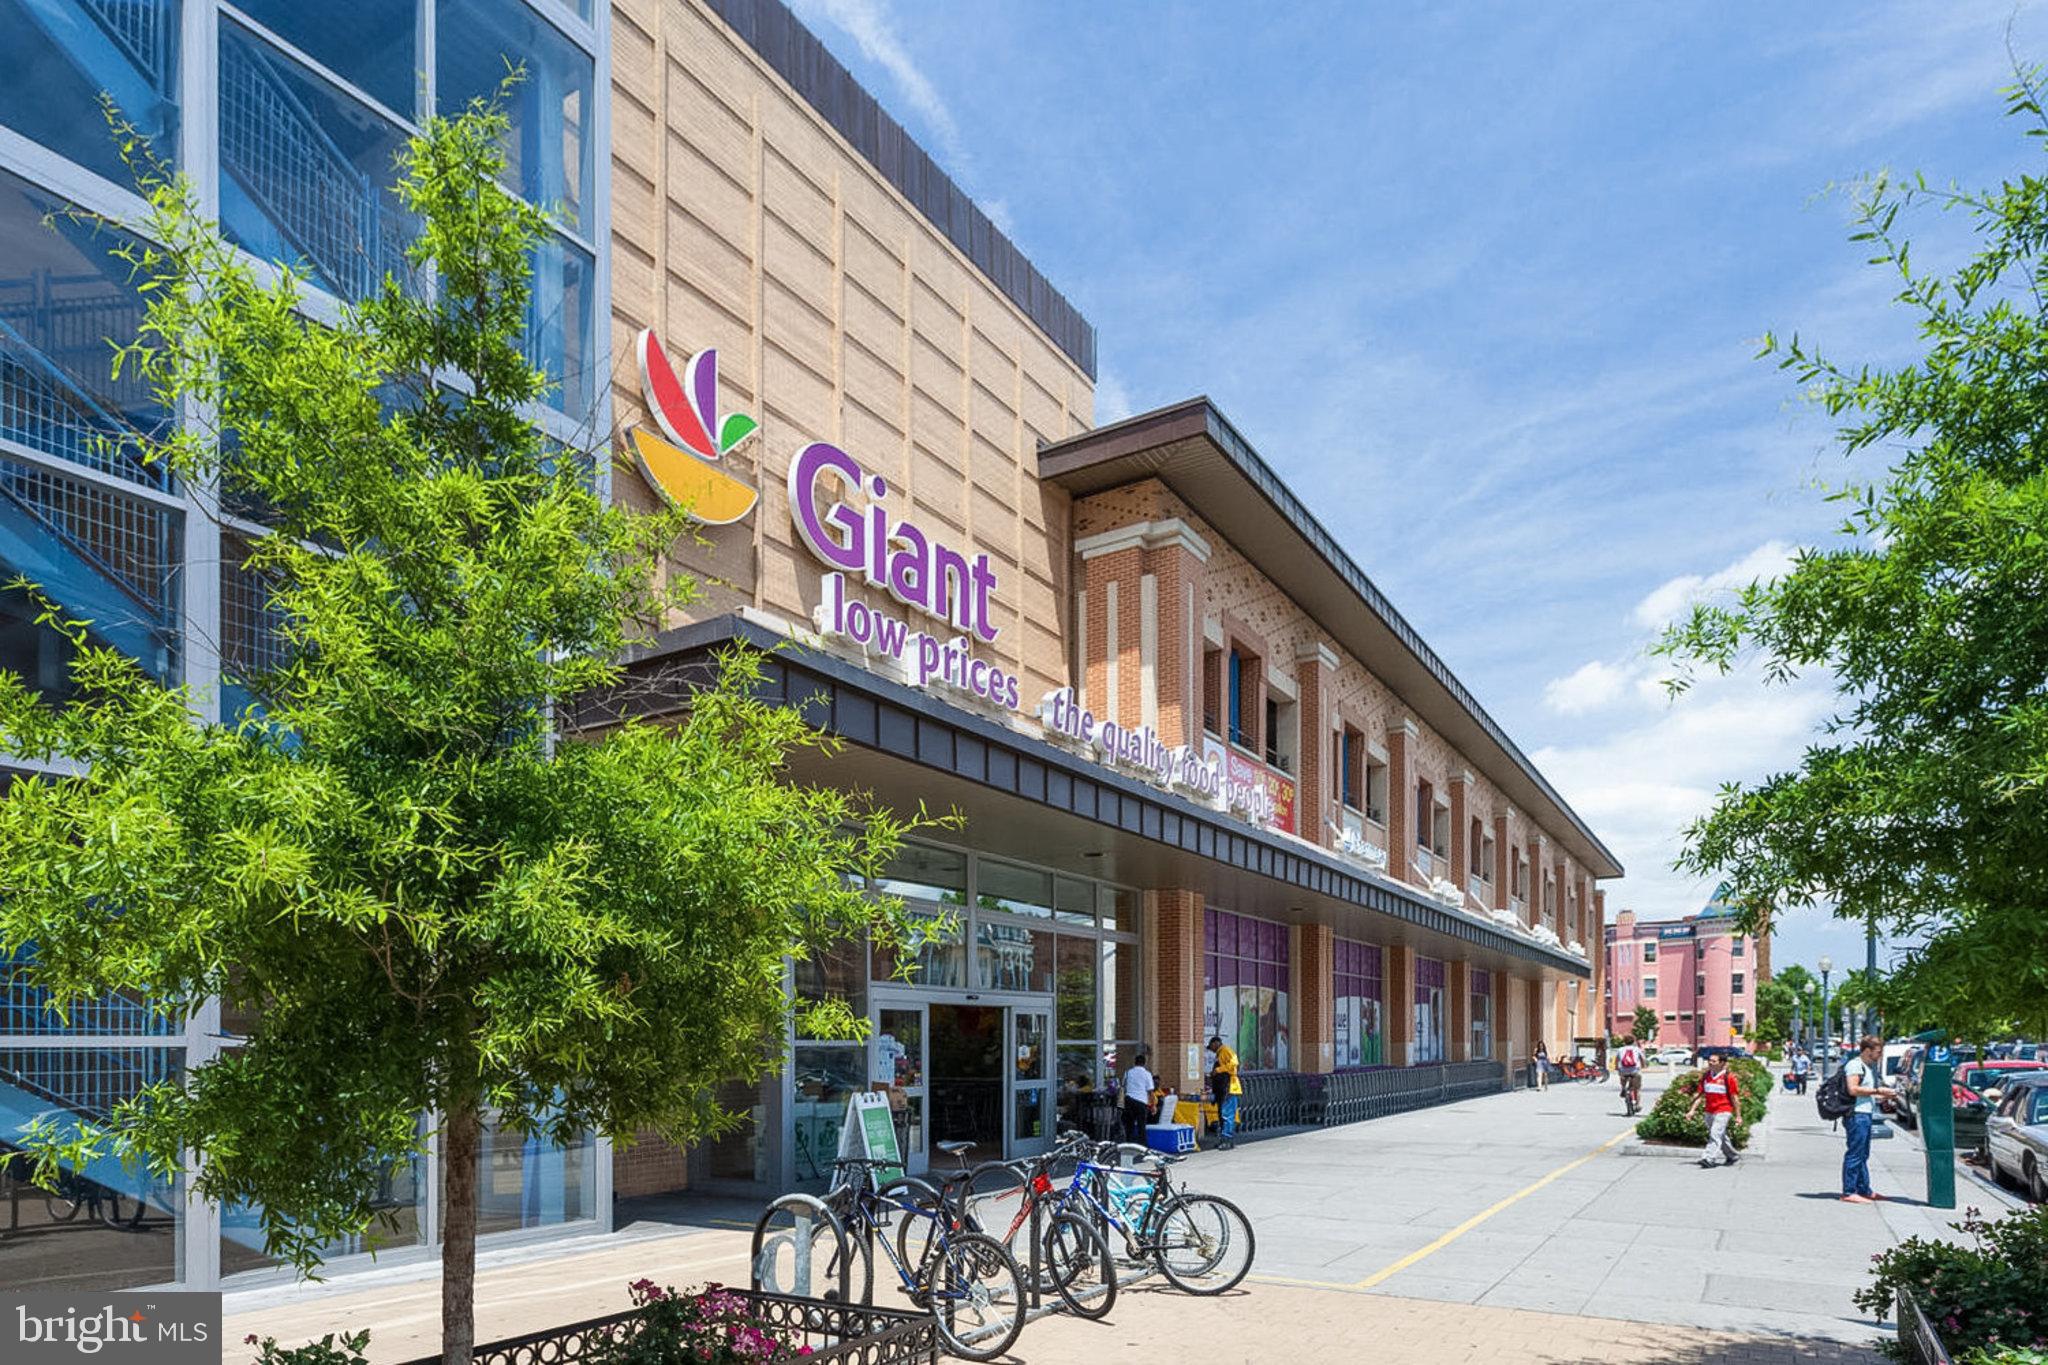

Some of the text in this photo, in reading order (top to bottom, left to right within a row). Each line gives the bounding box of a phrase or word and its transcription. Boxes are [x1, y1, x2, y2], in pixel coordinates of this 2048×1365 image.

[792, 441, 998, 642] Giant
[831, 572, 1020, 710] low prices
[1053, 688, 1095, 743] the
[1102, 721, 1176, 786] quality
[1181, 745, 1221, 799] food
